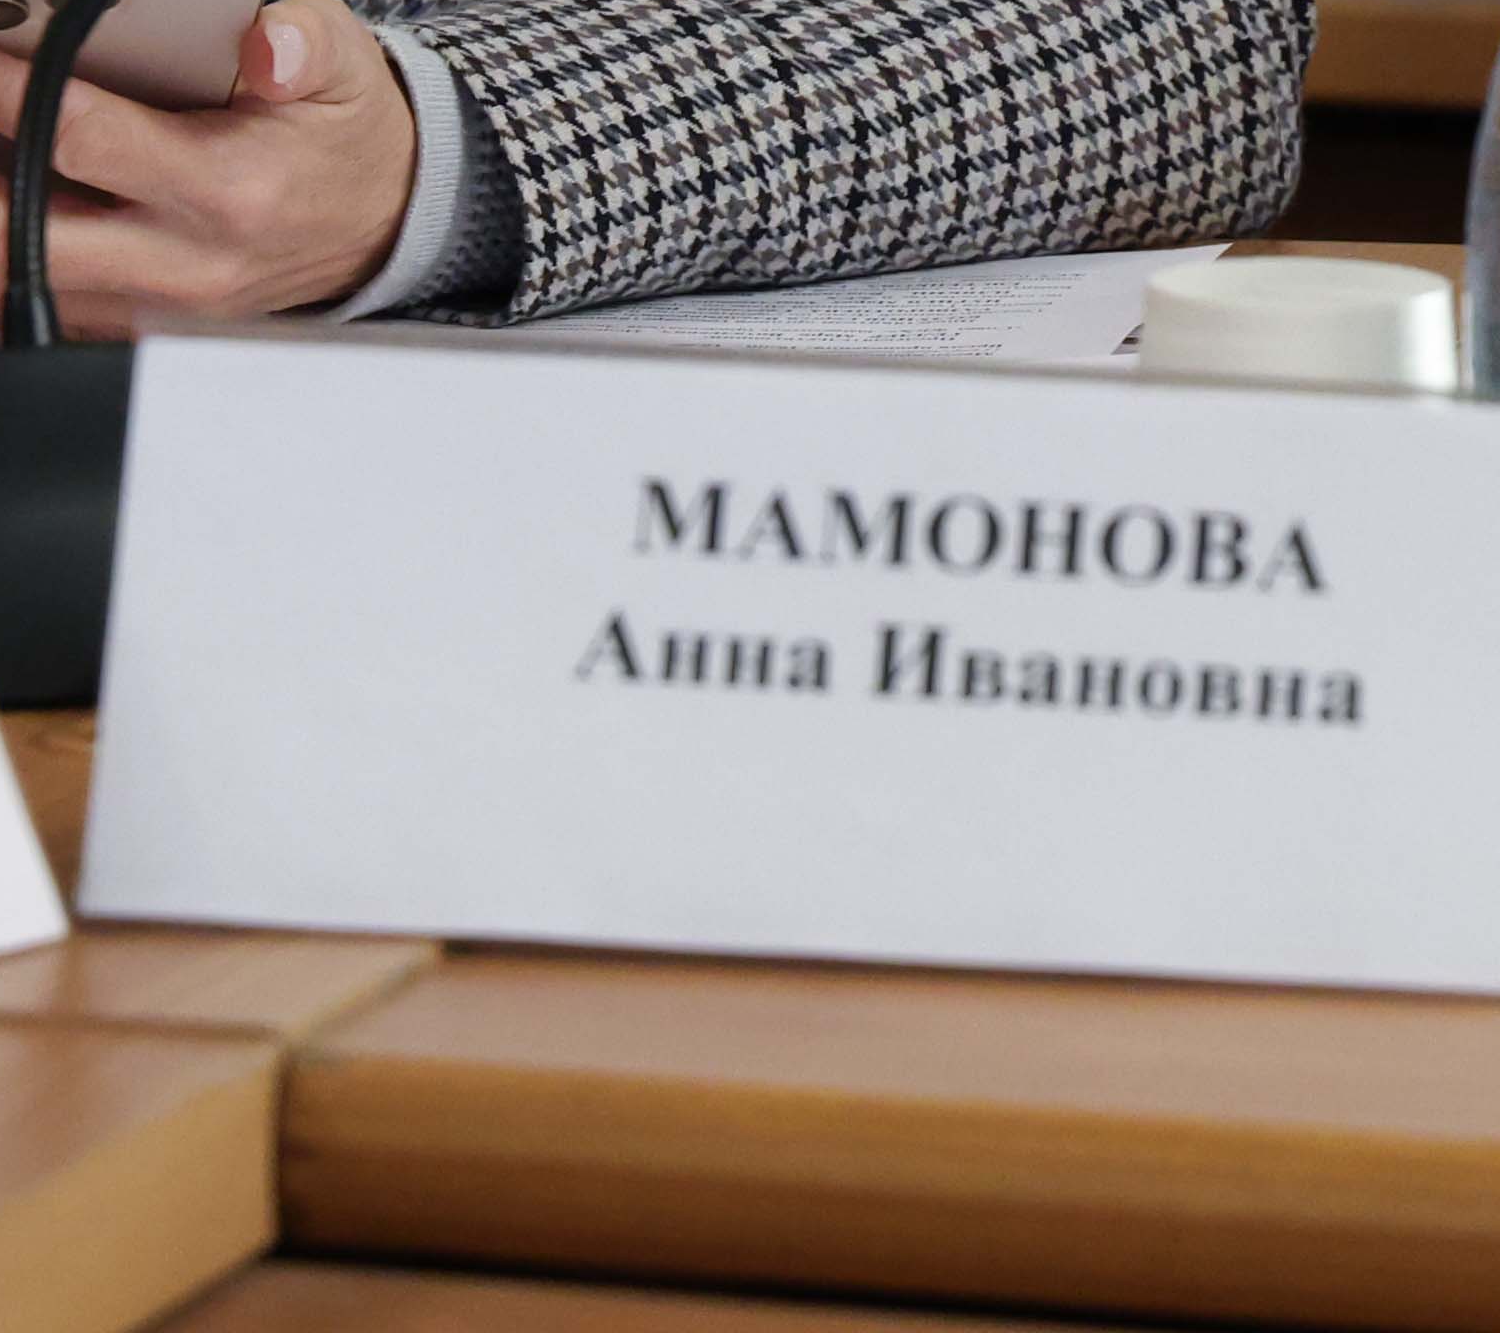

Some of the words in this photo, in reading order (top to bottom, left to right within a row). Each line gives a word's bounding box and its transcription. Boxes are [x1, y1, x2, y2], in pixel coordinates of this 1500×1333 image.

[633, 475, 1328, 597] МАМОНОВА
[576, 609, 834, 695] Анна
[870, 620, 1365, 727] Ивановна
